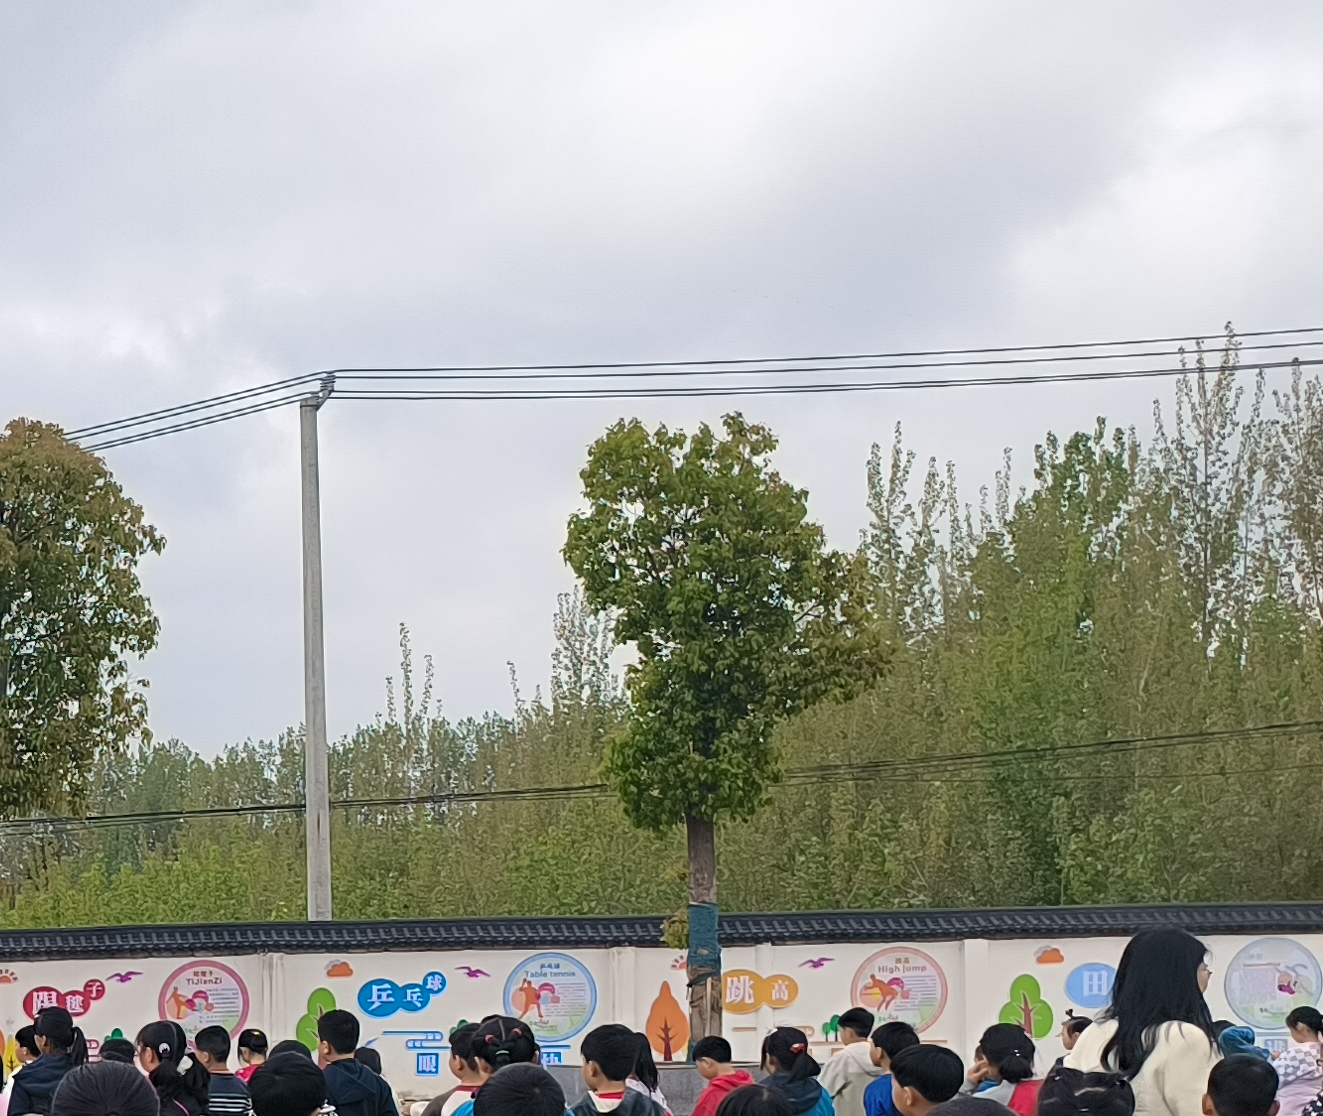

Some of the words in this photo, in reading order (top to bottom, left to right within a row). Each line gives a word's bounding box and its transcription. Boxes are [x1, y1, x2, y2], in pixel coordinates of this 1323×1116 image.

[367, 975, 443, 1011] 乒乓球
[725, 975, 789, 1004] 跳高
